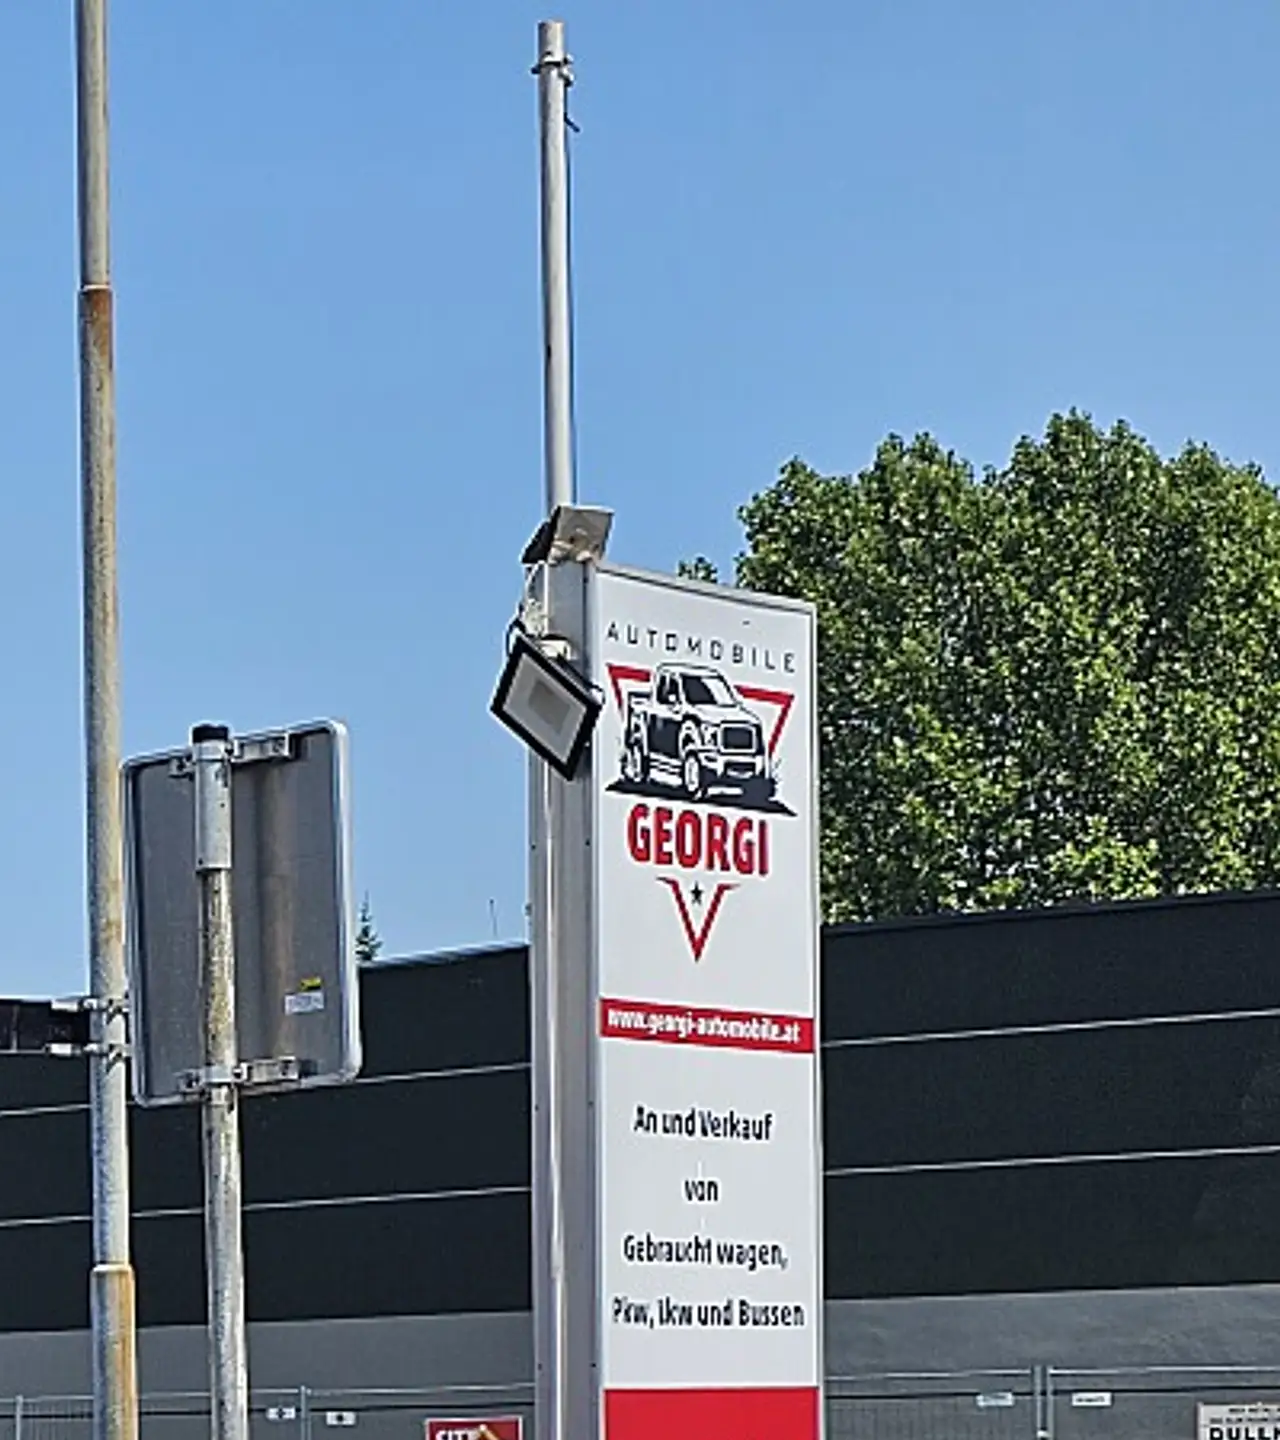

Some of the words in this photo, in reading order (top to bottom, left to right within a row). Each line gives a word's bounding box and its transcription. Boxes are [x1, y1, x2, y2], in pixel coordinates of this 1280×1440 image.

[607, 621, 795, 673] AUTOMOBILE
[627, 803, 769, 876] GEORGI
[634, 1106, 657, 1134] An
[662, 1108, 695, 1137] und
[699, 1110, 773, 1140] Verkauf
[697, 1300, 733, 1326] und
[739, 1300, 805, 1326] Bussen
